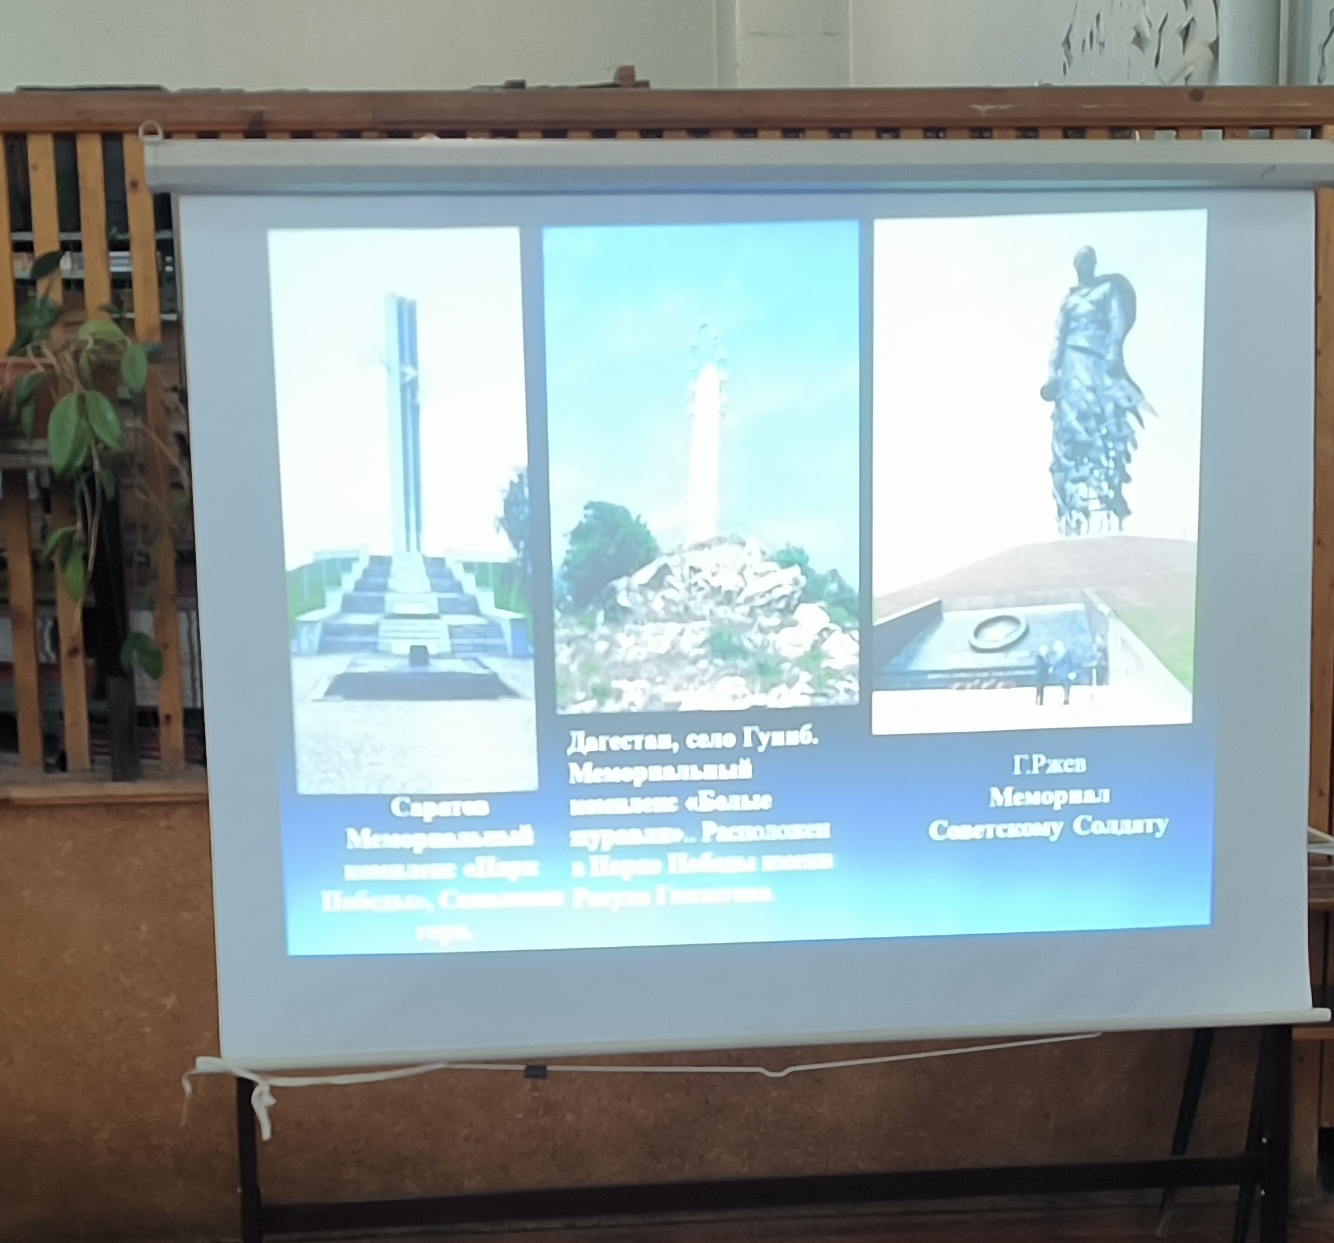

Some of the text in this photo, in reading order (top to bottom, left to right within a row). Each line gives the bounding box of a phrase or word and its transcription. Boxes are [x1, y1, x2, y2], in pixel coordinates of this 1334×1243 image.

[567, 730, 679, 755] Дагестан,
[569, 758, 753, 787] Мемориальный
[1013, 753, 1087, 775] Г.Ржев
[390, 796, 490, 822] Саратов
[989, 786, 1110, 811] Мемориал
[928, 815, 1169, 842] Советскому Солдату
